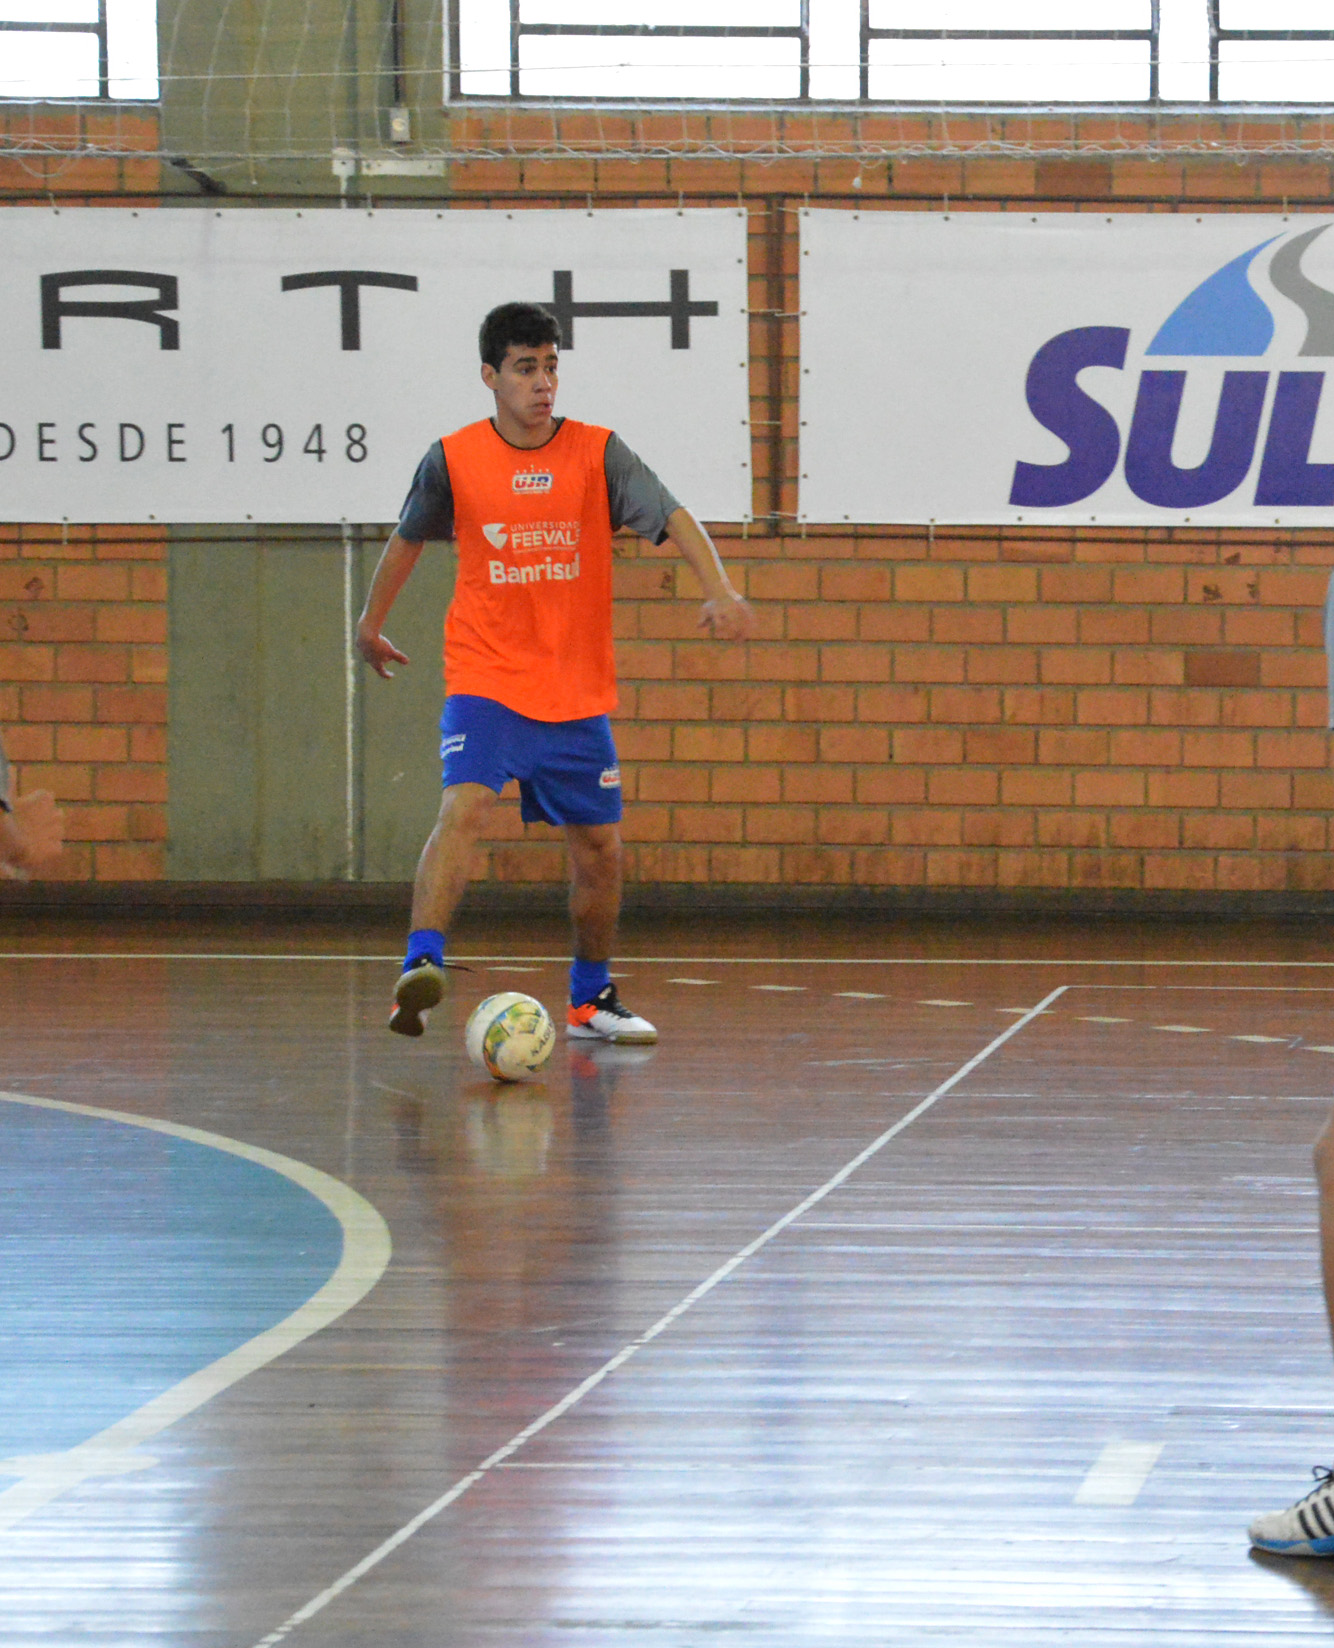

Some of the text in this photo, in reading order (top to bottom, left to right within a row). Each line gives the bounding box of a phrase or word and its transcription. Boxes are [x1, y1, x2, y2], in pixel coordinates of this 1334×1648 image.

[0, 422, 369, 464] DESDE 1948
[510, 521, 580, 533] UNIVERSIDAD
[488, 551, 581, 584] Banrisul
